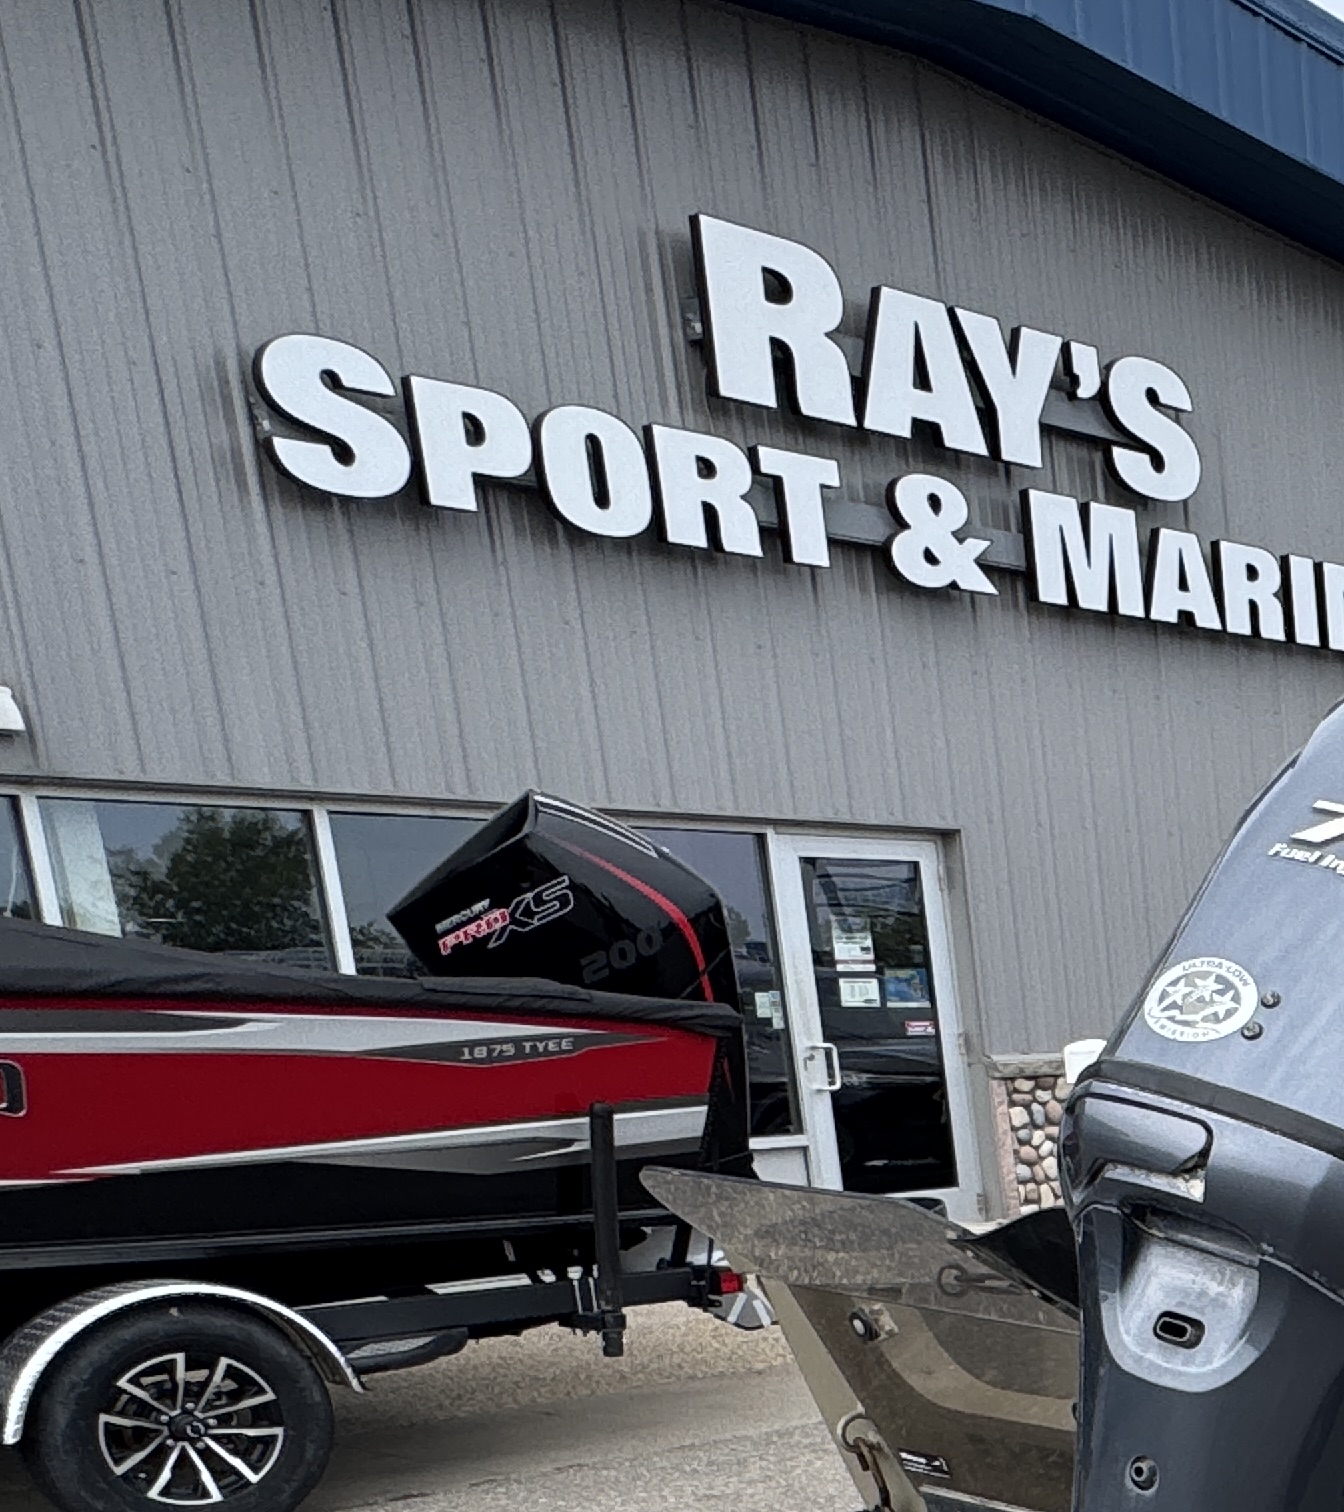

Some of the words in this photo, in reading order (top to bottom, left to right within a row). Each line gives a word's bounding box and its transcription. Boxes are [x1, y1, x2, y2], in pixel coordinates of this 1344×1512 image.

[693, 213, 1201, 501] RAY'S
[256, 333, 841, 567] SPORT
[890, 473, 998, 595] &
[1267, 842, 1321, 864] Fuel
[521, 1037, 575, 1055] TYEE
